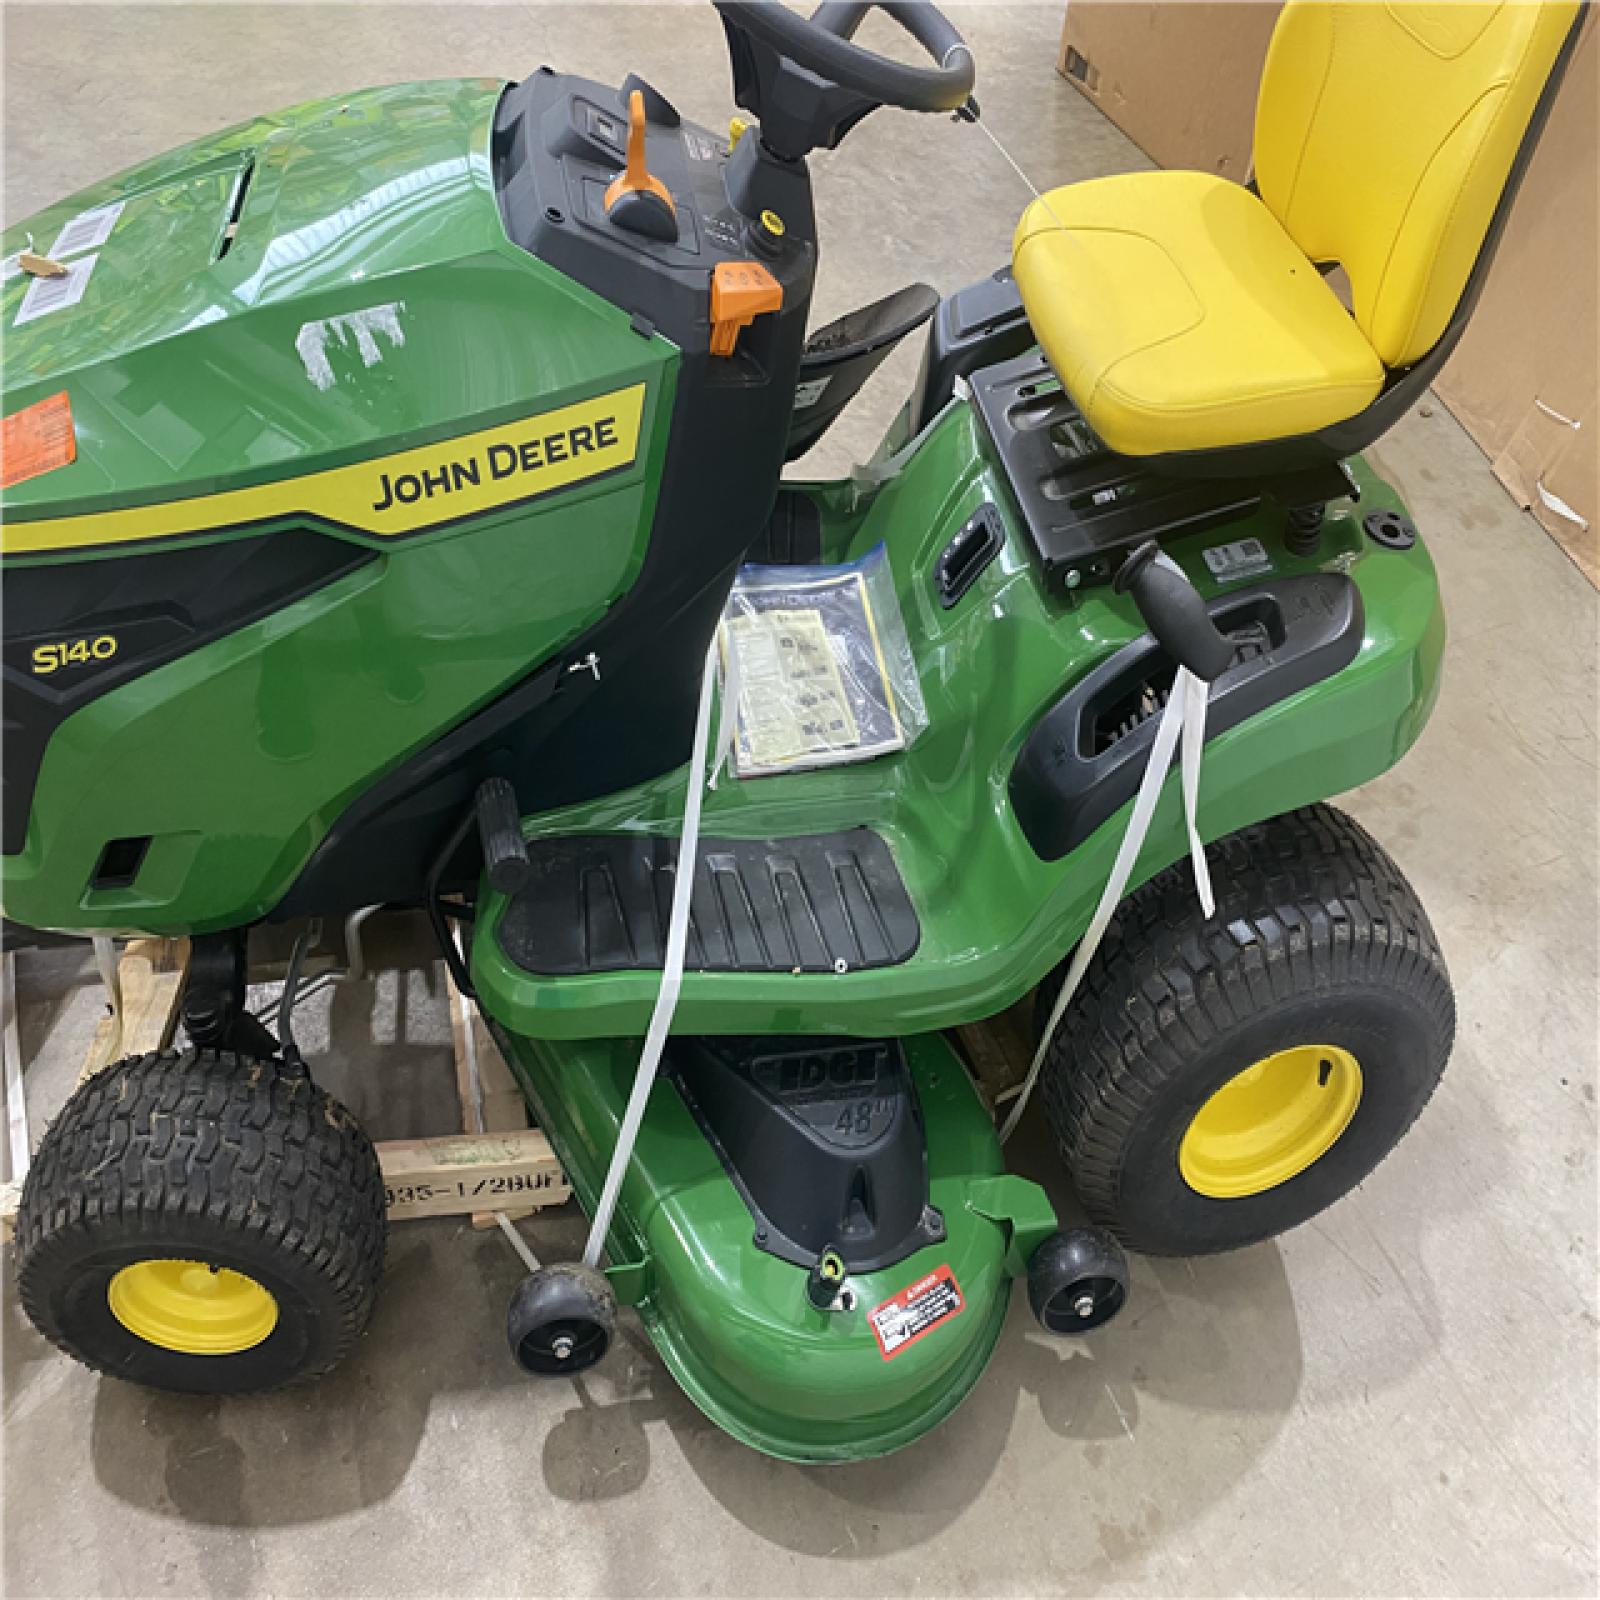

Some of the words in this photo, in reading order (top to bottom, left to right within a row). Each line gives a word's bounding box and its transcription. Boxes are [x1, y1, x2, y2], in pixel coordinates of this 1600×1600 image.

[372, 457, 481, 512] JOHN
[487, 416, 619, 481] DEERE
[31, 634, 118, 674] S140
